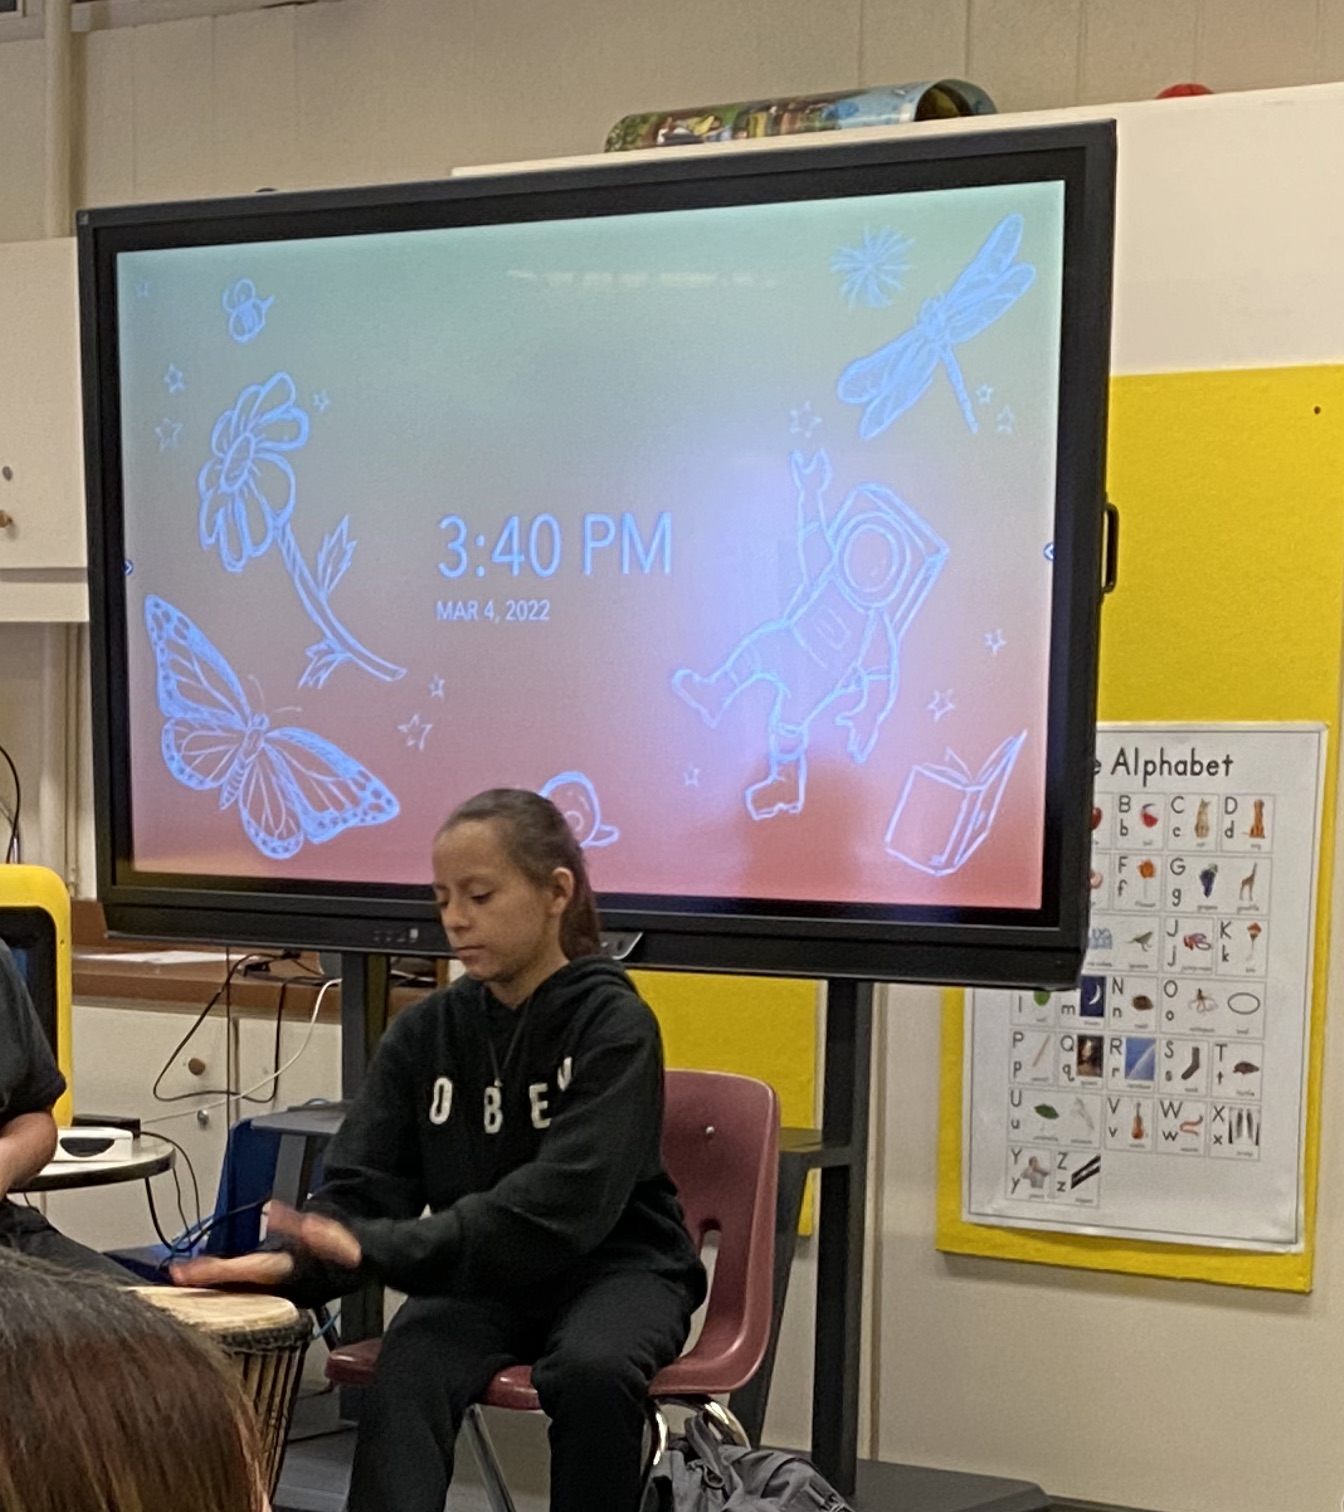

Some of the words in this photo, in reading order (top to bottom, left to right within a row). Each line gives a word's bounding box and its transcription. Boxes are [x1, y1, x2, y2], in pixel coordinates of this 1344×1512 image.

[438, 513, 561, 578] 3:40
[583, 511, 672, 576] PM
[436, 600, 478, 621] MAR
[484, 600, 499, 624] 4,
[506, 599, 550, 621] 2022
[1111, 747, 1233, 787] Alphabet
[1119, 795, 1131, 813] B
[1171, 796, 1184, 814] C
[1225, 796, 1238, 815] D
[1120, 818, 1129, 836] b
[1173, 826, 1181, 837] c
[1224, 820, 1234, 839] d
[1119, 856, 1128, 874] F
[1170, 857, 1186, 875] G
[1118, 879, 1127, 897] f
[1172, 888, 1181, 907] g
[1167, 919, 1179, 937] J
[1220, 921, 1232, 939] K
[1222, 944, 1229, 962] k
[1112, 976, 1124, 995] N
[1164, 980, 1178, 998] O
[1061, 1004, 1076, 1016] m
[1112, 1007, 1122, 1018] n
[1165, 1010, 1174, 1021] o
[1013, 1031, 1024, 1048] P
[1060, 1035, 1074, 1052] Q
[1110, 1038, 1122, 1055] R
[1164, 1040, 1174, 1059] S
[1215, 1043, 1228, 1062] T
[1013, 1061, 1022, 1078] p
[1062, 1064, 1075, 1082] q
[1112, 1067, 1120, 1078] r
[1217, 1071, 1224, 1085] t
[1010, 1090, 1022, 1107] U
[1108, 1097, 1120, 1114] V
[1160, 1100, 1183, 1119] W
[1212, 1105, 1225, 1122] X
[1011, 1119, 1020, 1129] u
[1108, 1127, 1117, 1138] v
[1162, 1130, 1178, 1141] w
[1213, 1134, 1223, 1146] x
[1011, 1148, 1022, 1165] Y
[1057, 1151, 1068, 1171] Z
[1011, 1178, 1020, 1195] y
[1056, 1181, 1066, 1192] z
